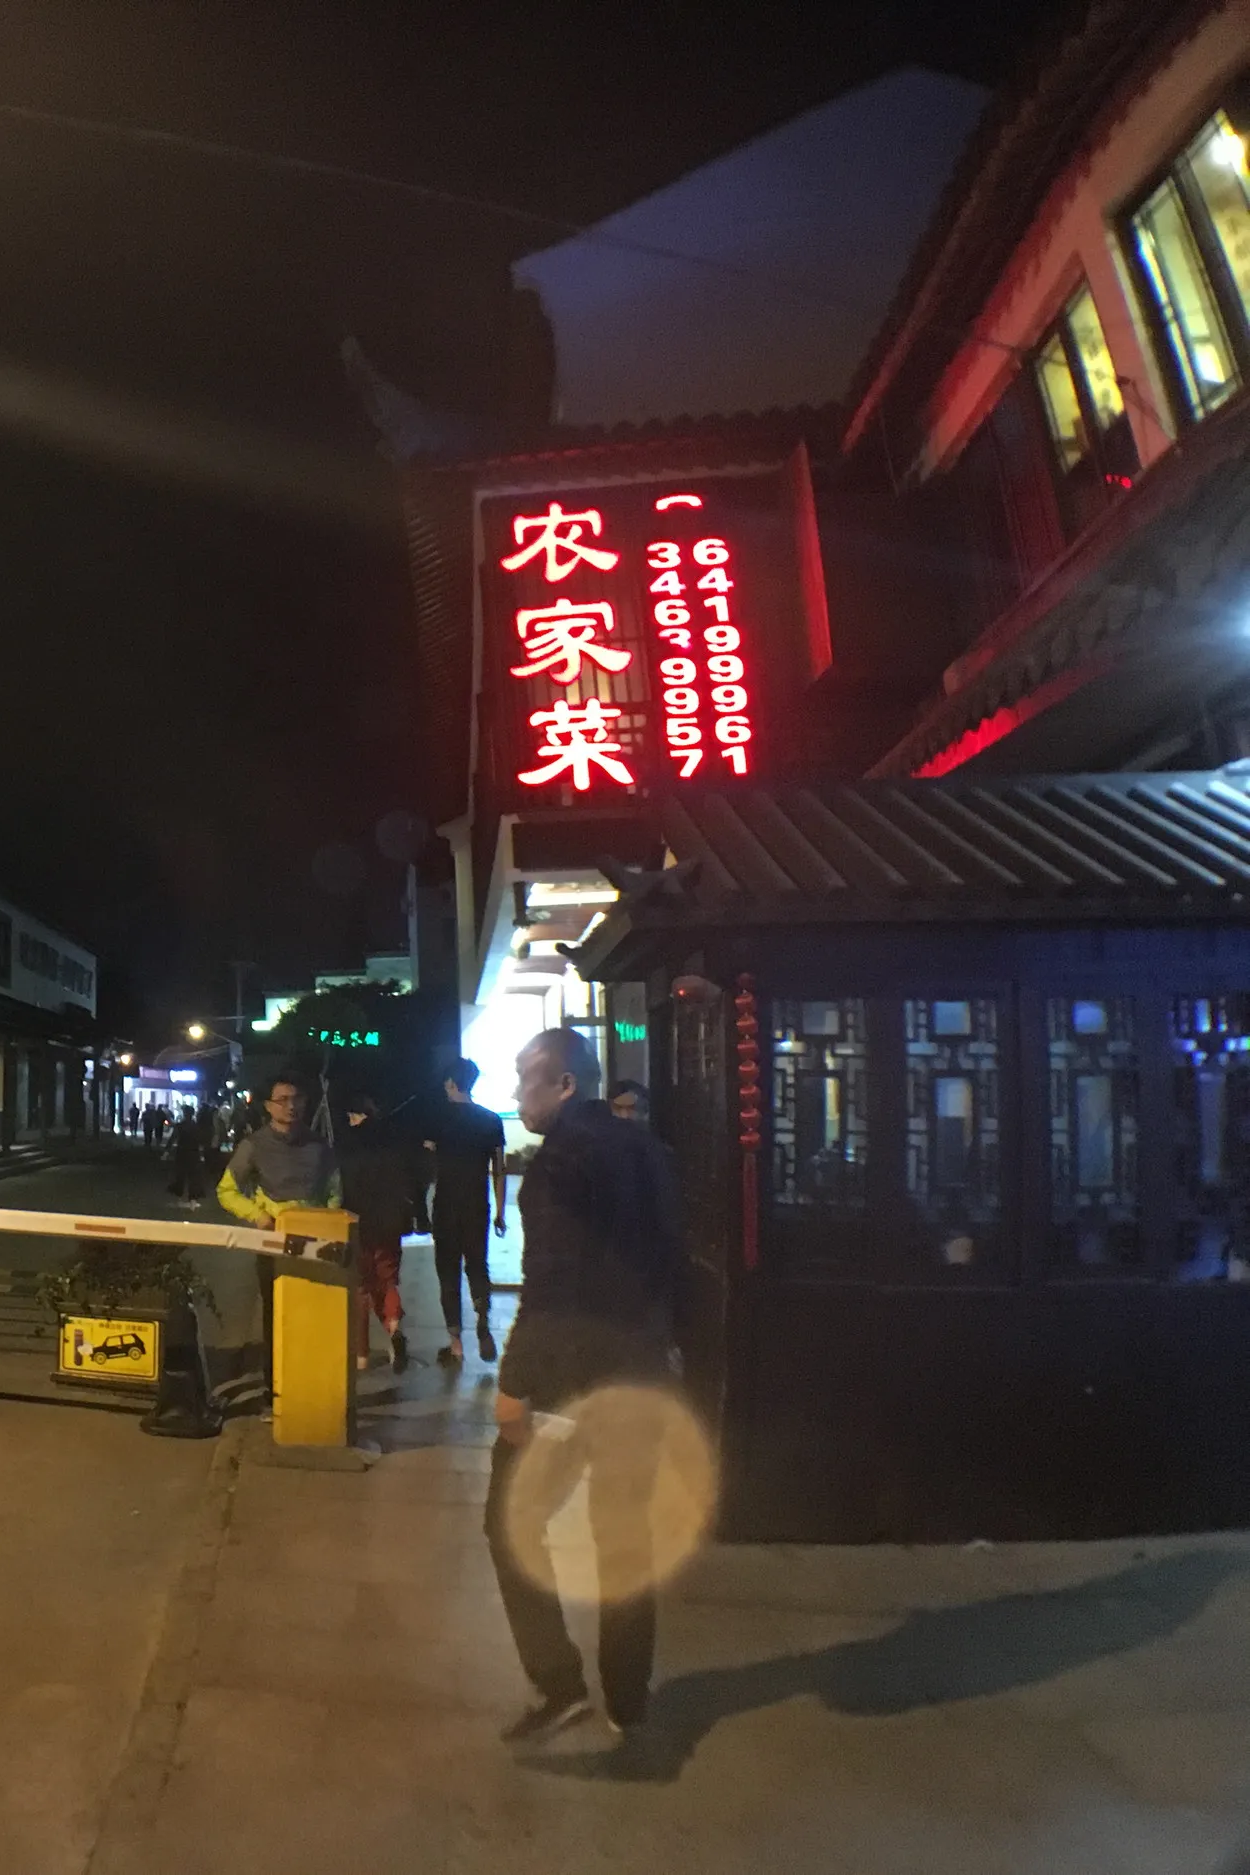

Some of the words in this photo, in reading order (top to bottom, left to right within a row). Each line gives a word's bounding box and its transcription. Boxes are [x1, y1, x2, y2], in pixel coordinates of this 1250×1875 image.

[500, 502, 635, 791] 农家菜
[692, 538, 752, 775] 64199961
